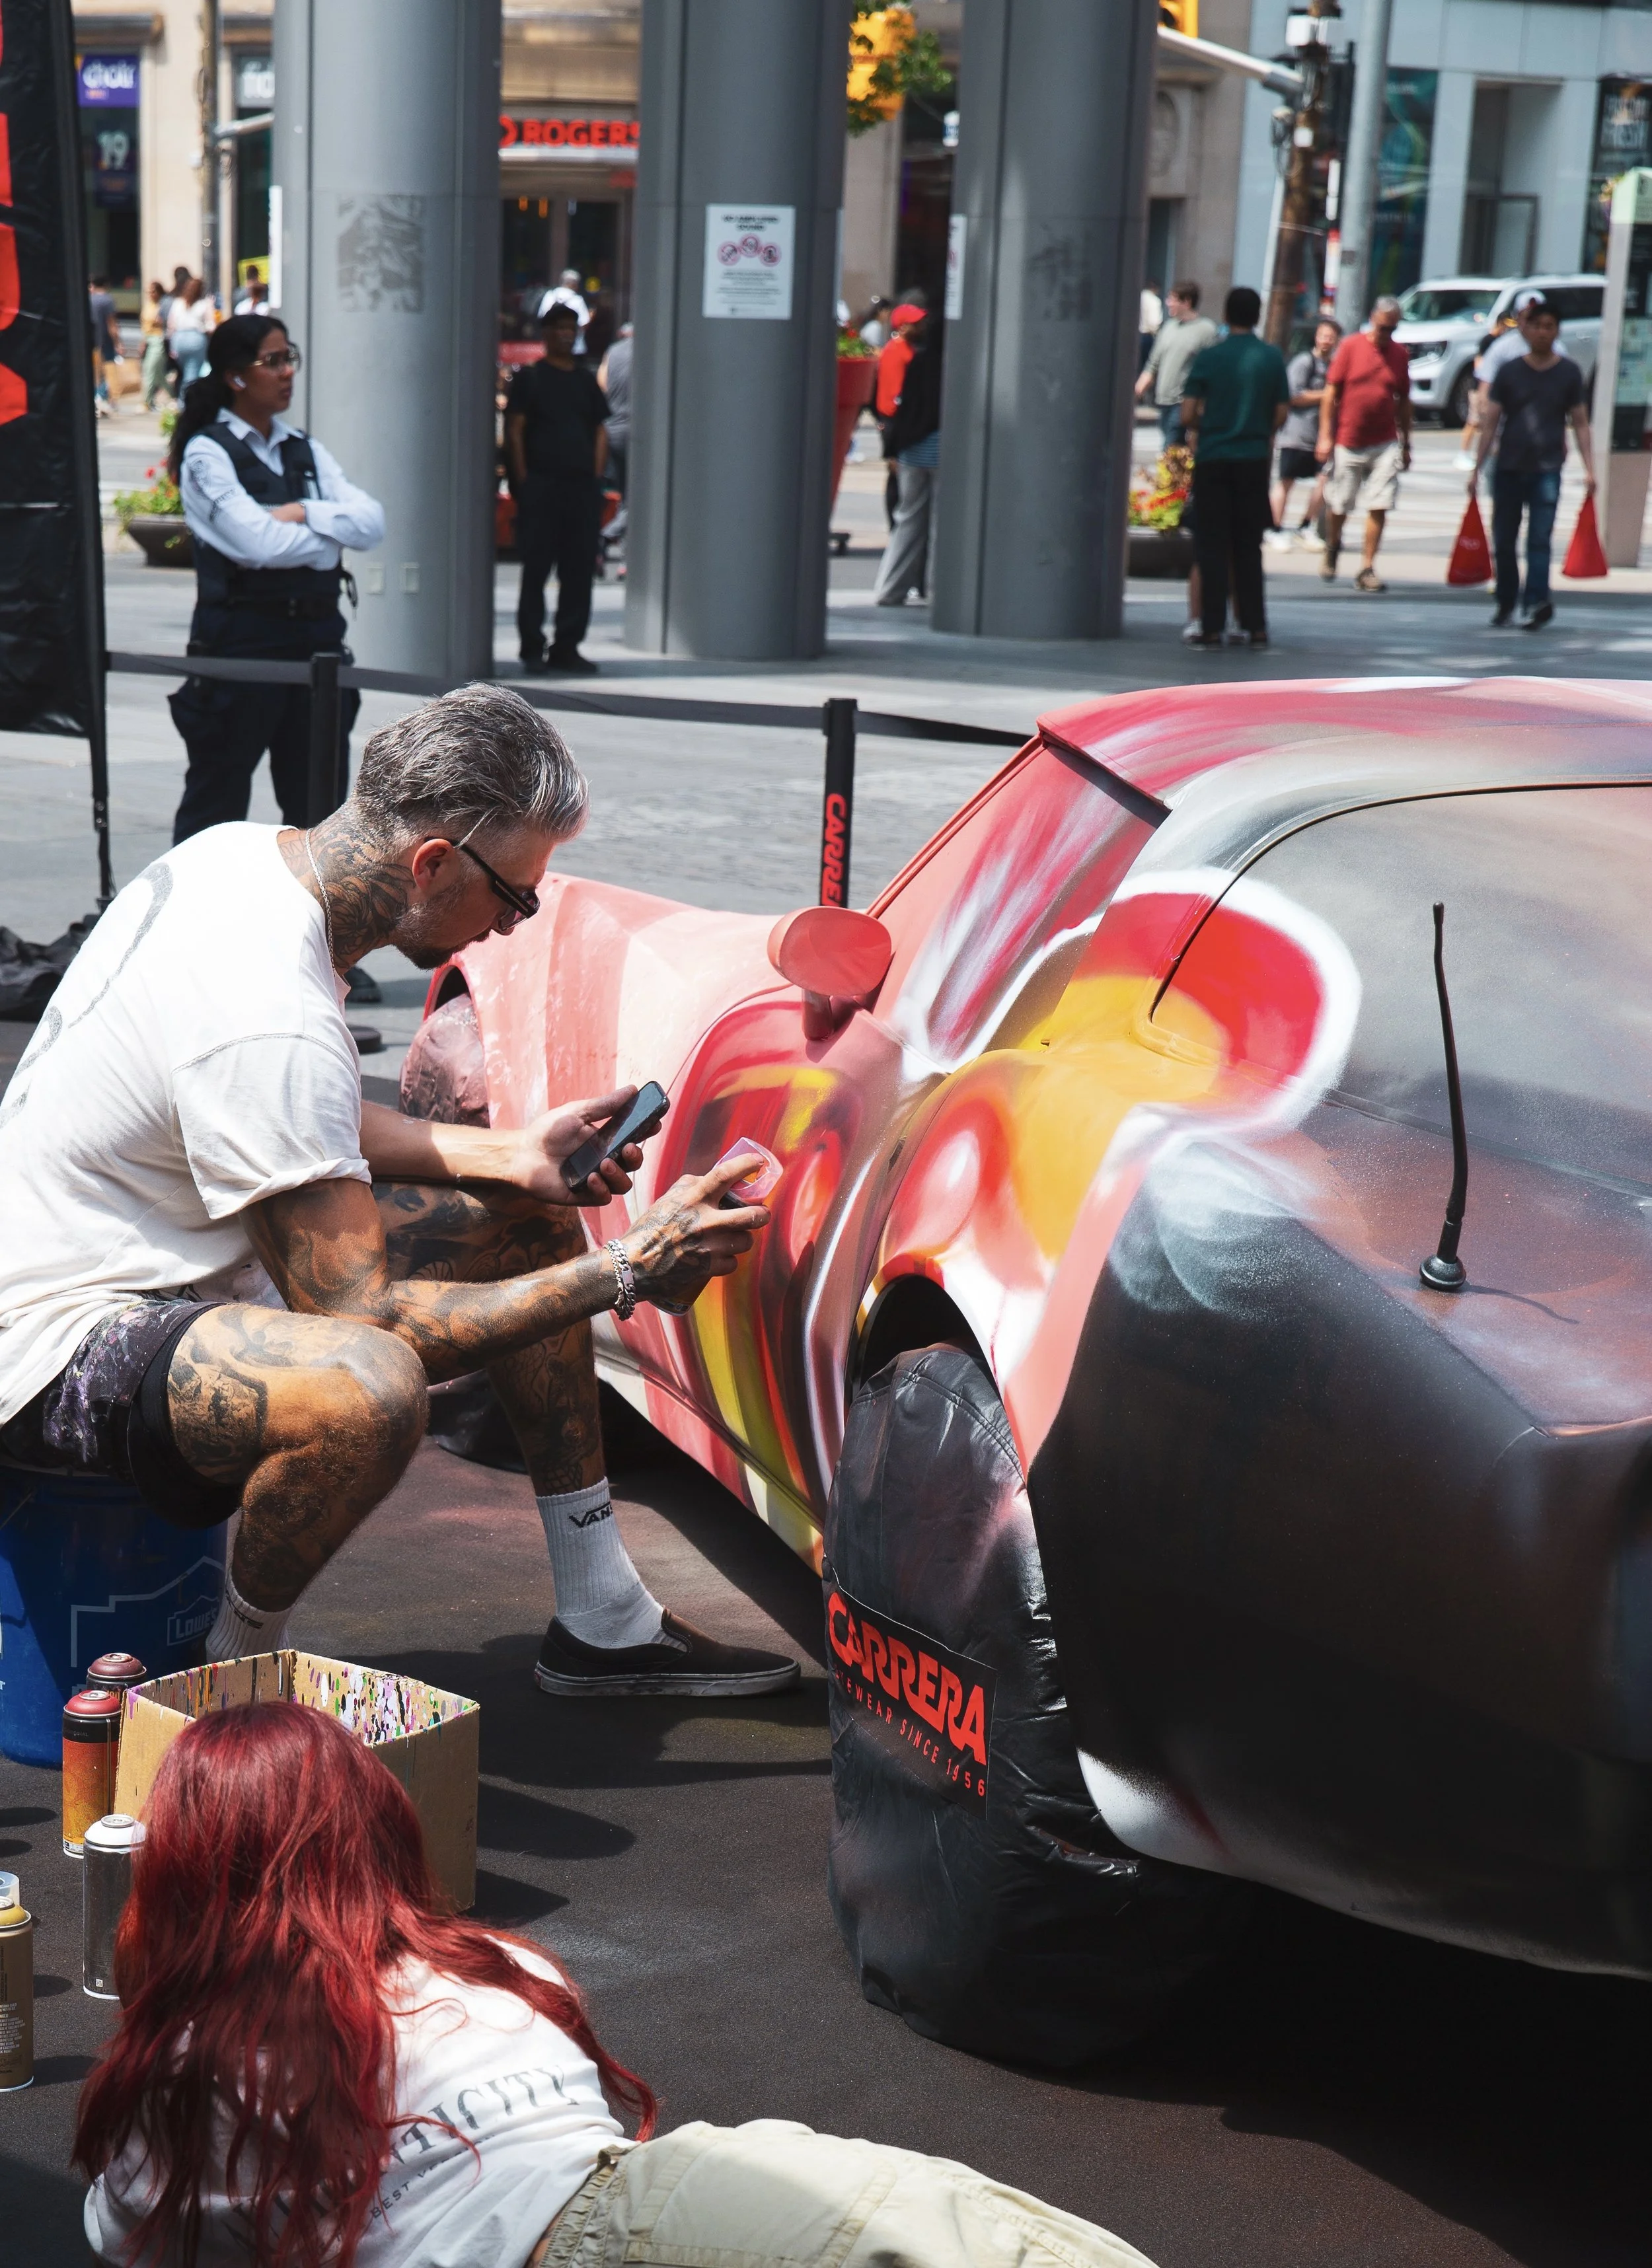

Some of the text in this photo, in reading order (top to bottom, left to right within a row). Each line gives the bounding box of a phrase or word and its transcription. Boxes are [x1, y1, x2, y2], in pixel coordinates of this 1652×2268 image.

[821, 793, 846, 906] CARRE
[828, 1591, 987, 1765] CARRERA
[900, 1719, 940, 1764] SINCE
[946, 1759, 985, 1796] 1956
[371, 2181, 410, 2218] BEST
